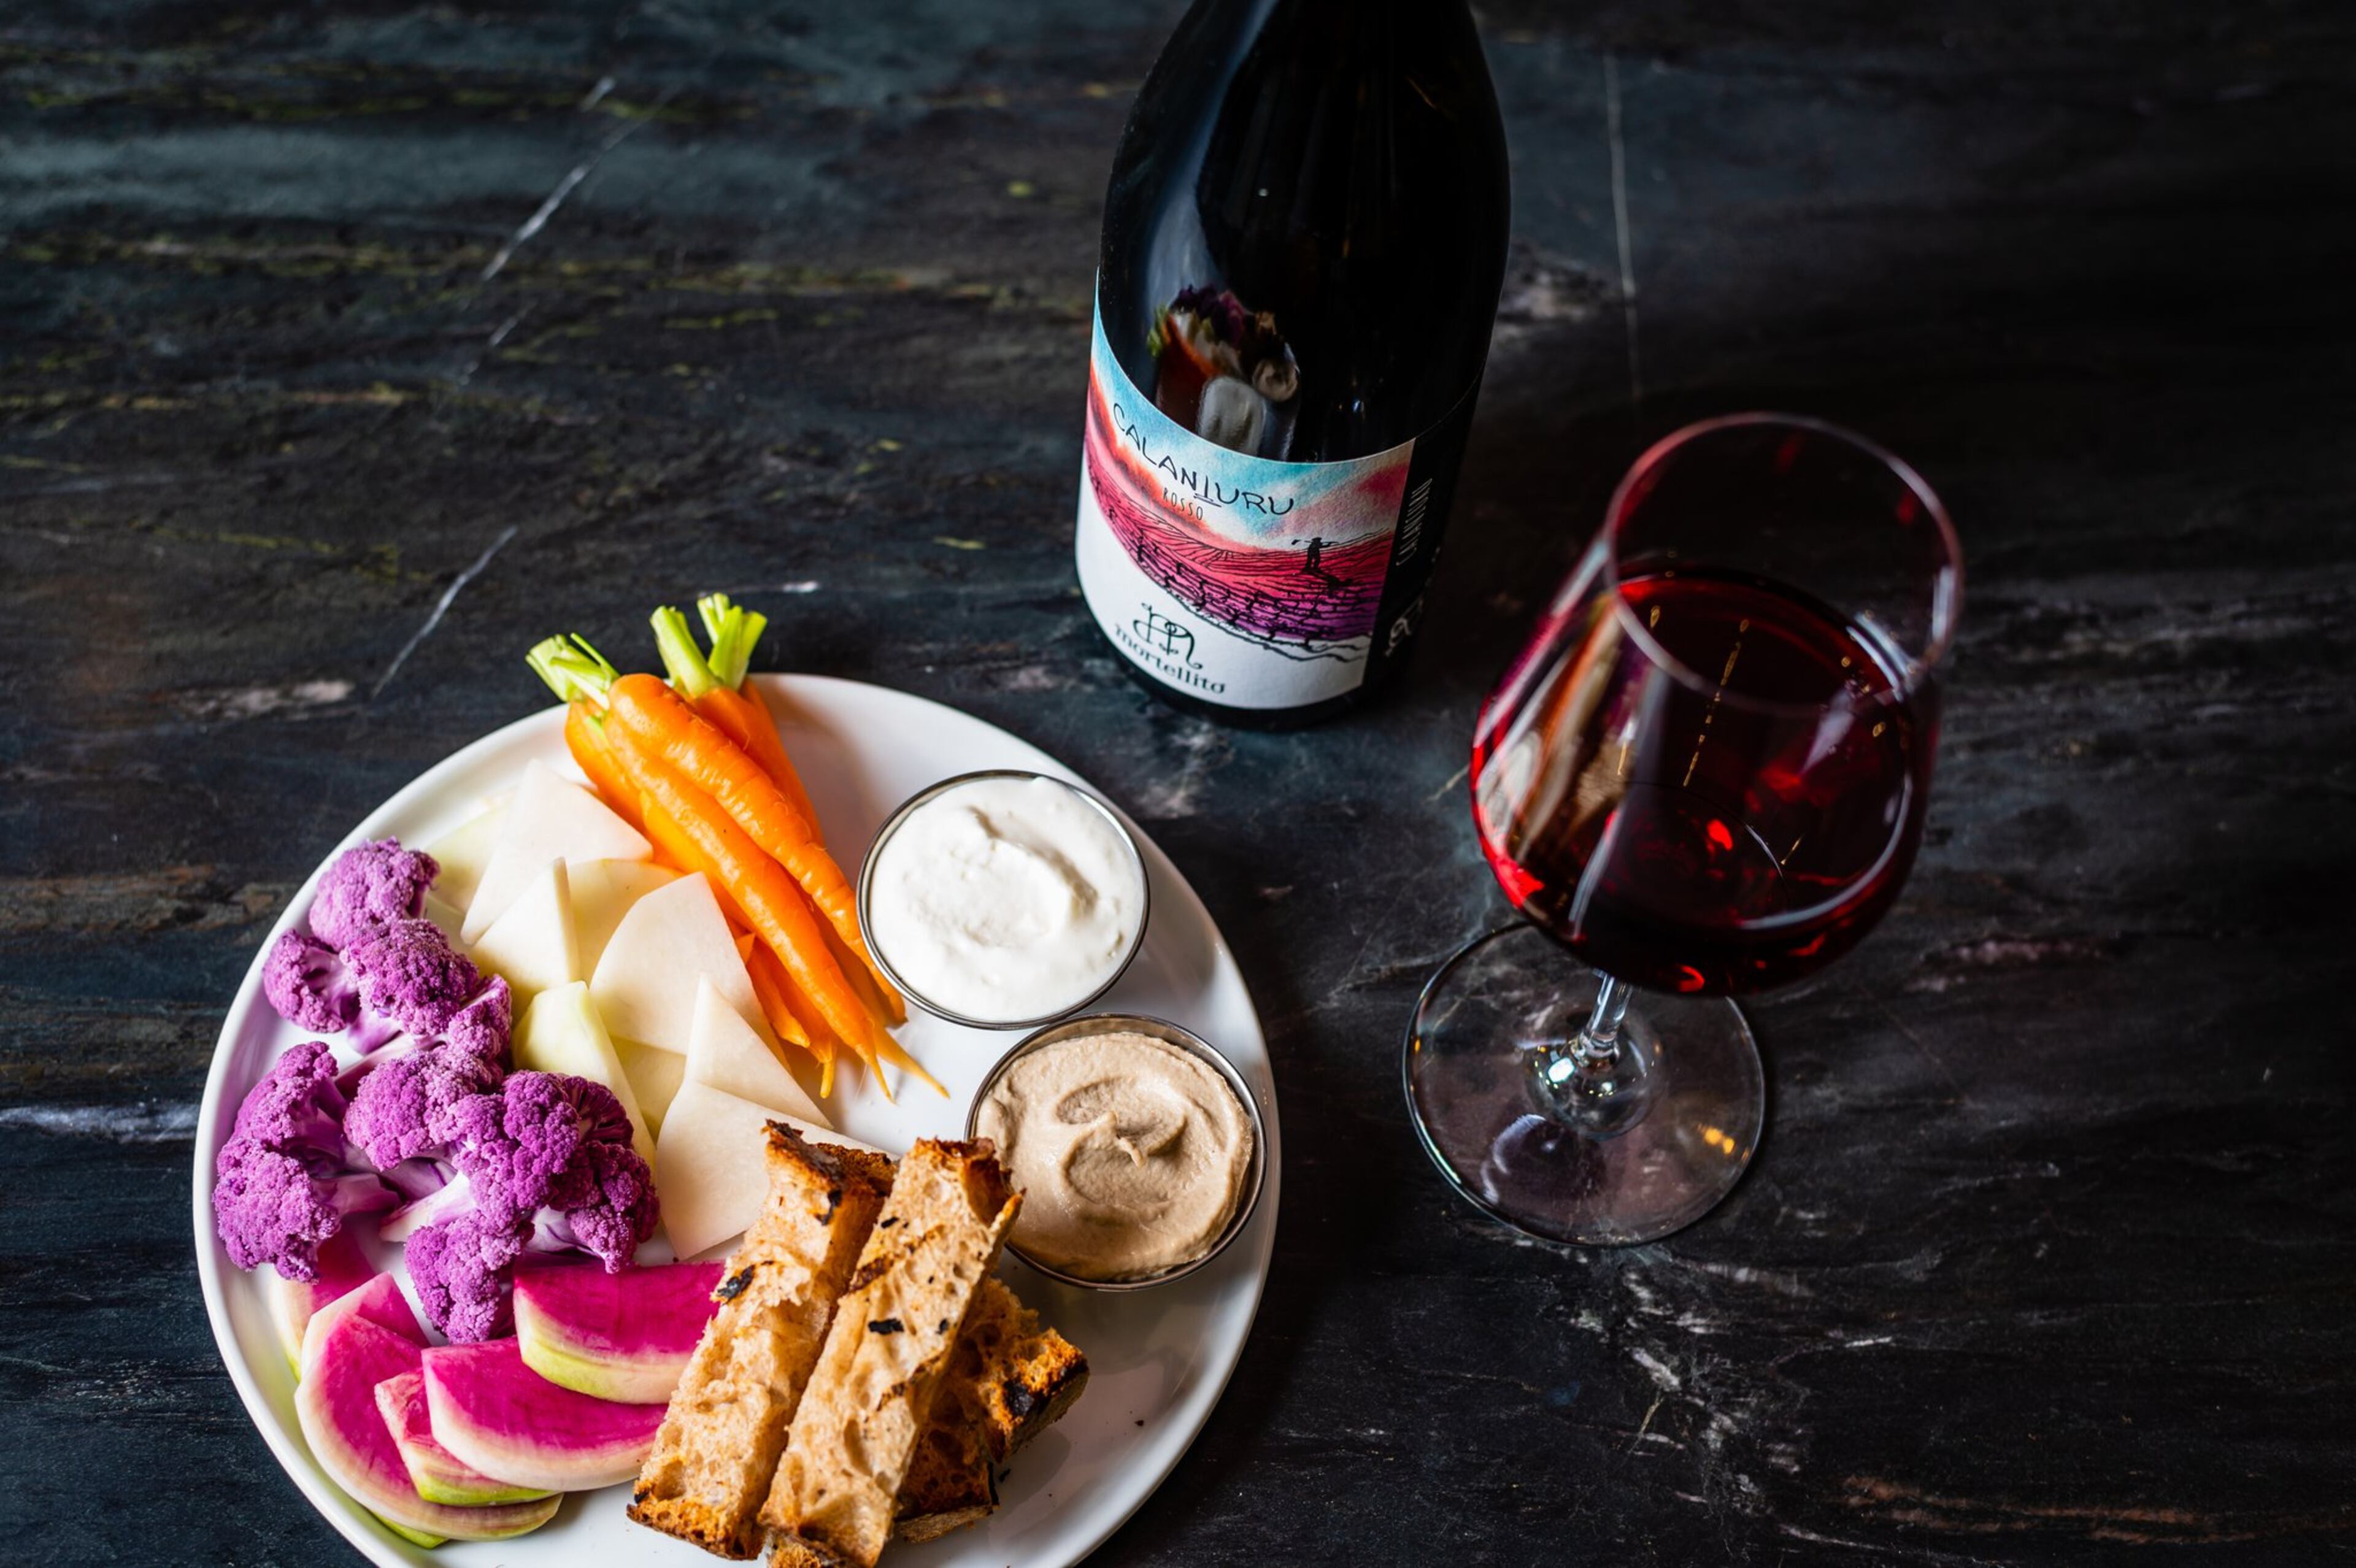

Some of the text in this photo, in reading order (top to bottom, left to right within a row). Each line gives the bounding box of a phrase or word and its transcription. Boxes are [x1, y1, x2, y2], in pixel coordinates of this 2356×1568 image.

[1113, 402, 1294, 515] CALANIURU
[1163, 486, 1204, 521] ROSSO
[1114, 622, 1226, 694] mortellito
